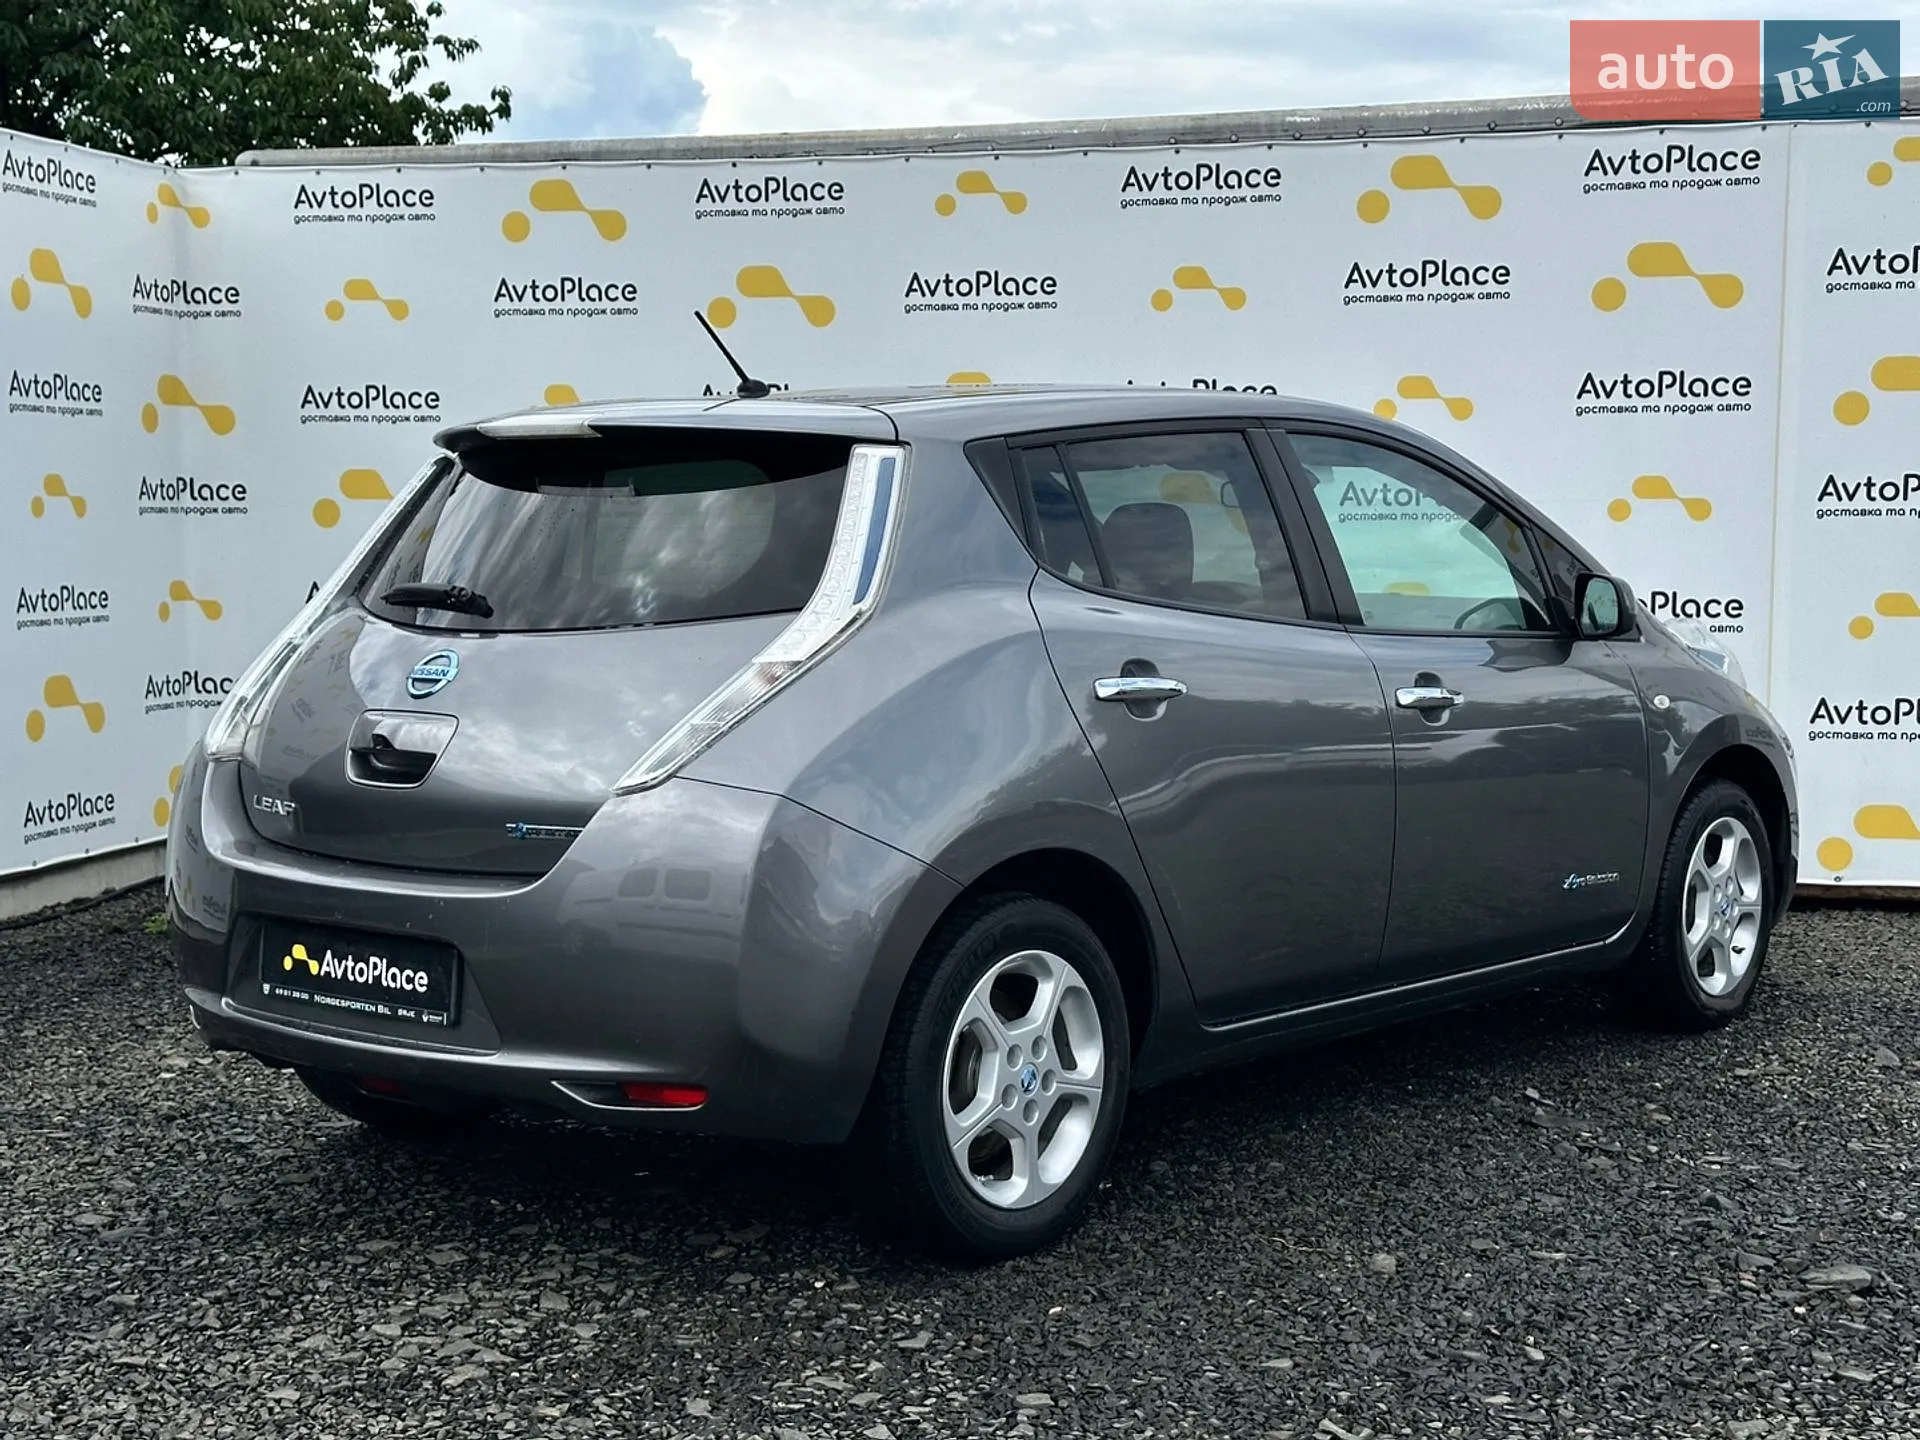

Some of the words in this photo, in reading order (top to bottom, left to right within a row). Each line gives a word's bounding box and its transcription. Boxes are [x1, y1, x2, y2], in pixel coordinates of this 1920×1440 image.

[3, 149, 96, 193] AvtoPlace
[1584, 144, 1761, 177] AvtoPlace
[696, 176, 844, 204] AvtoPlace
[1121, 163, 1281, 193] AvtoPlace
[1583, 181, 1646, 194] доставка
[1649, 180, 1669, 189] та
[1672, 178, 1722, 191] продаж
[1725, 176, 1760, 186] авто
[294, 183, 434, 209] AvtoPlace
[1120, 197, 1178, 209] доставка
[1181, 196, 1199, 205] та
[1201, 195, 1247, 207] продаж
[1250, 194, 1282, 203] авто
[294, 215, 345, 225] доставка
[347, 214, 363, 223] та
[365, 213, 405, 224] продаж
[407, 213, 436, 221] авто
[695, 209, 749, 220] доставка
[751, 209, 768, 217] та
[771, 208, 813, 218] продаж
[815, 207, 845, 215] авто
[905, 270, 1057, 298] AvtoPlace
[1344, 259, 1510, 289] AvtoPlace
[133, 274, 240, 305] AvtoPlace
[494, 277, 637, 303] AvtoPlace
[1343, 294, 1403, 306] доставка
[1406, 294, 1424, 303] та
[1427, 292, 1475, 304] продаж
[1478, 291, 1512, 301] авто
[1826, 282, 1892, 294] доставка
[1895, 281, 1916, 290] та
[493, 308, 546, 318] доставка
[548, 308, 564, 316] та
[567, 308, 607, 318] продаж
[609, 308, 638, 316] авто
[904, 303, 959, 314] доставка
[962, 303, 978, 311] та
[982, 302, 1025, 313] продаж
[1027, 301, 1058, 310] авто
[9, 370, 102, 403] AvtoPlace
[301, 384, 440, 409] AvtoPlace
[1577, 370, 1751, 400] AvtoPlace
[300, 415, 351, 425] доставка
[353, 415, 369, 423] та
[371, 415, 411, 424] продаж
[1575, 405, 1638, 417] доставка
[1641, 405, 1661, 413] та
[1664, 403, 1714, 415] продаж
[1716, 403, 1752, 412] авто
[139, 476, 247, 501] AvtoPlace
[1816, 509, 1882, 520] доставка
[1886, 508, 1906, 517] та
[17, 585, 108, 614] AvtoPlace
[1638, 591, 1744, 619] Place
[1709, 625, 1744, 634] авто
[145, 670, 239, 700] AvtoPlac
[1808, 731, 1874, 741] доставка
[1877, 732, 1897, 740] та
[24, 792, 115, 828] AvtoPlace
[254, 794, 296, 817] LEAF
[320, 950, 429, 993] AvtoPlace
